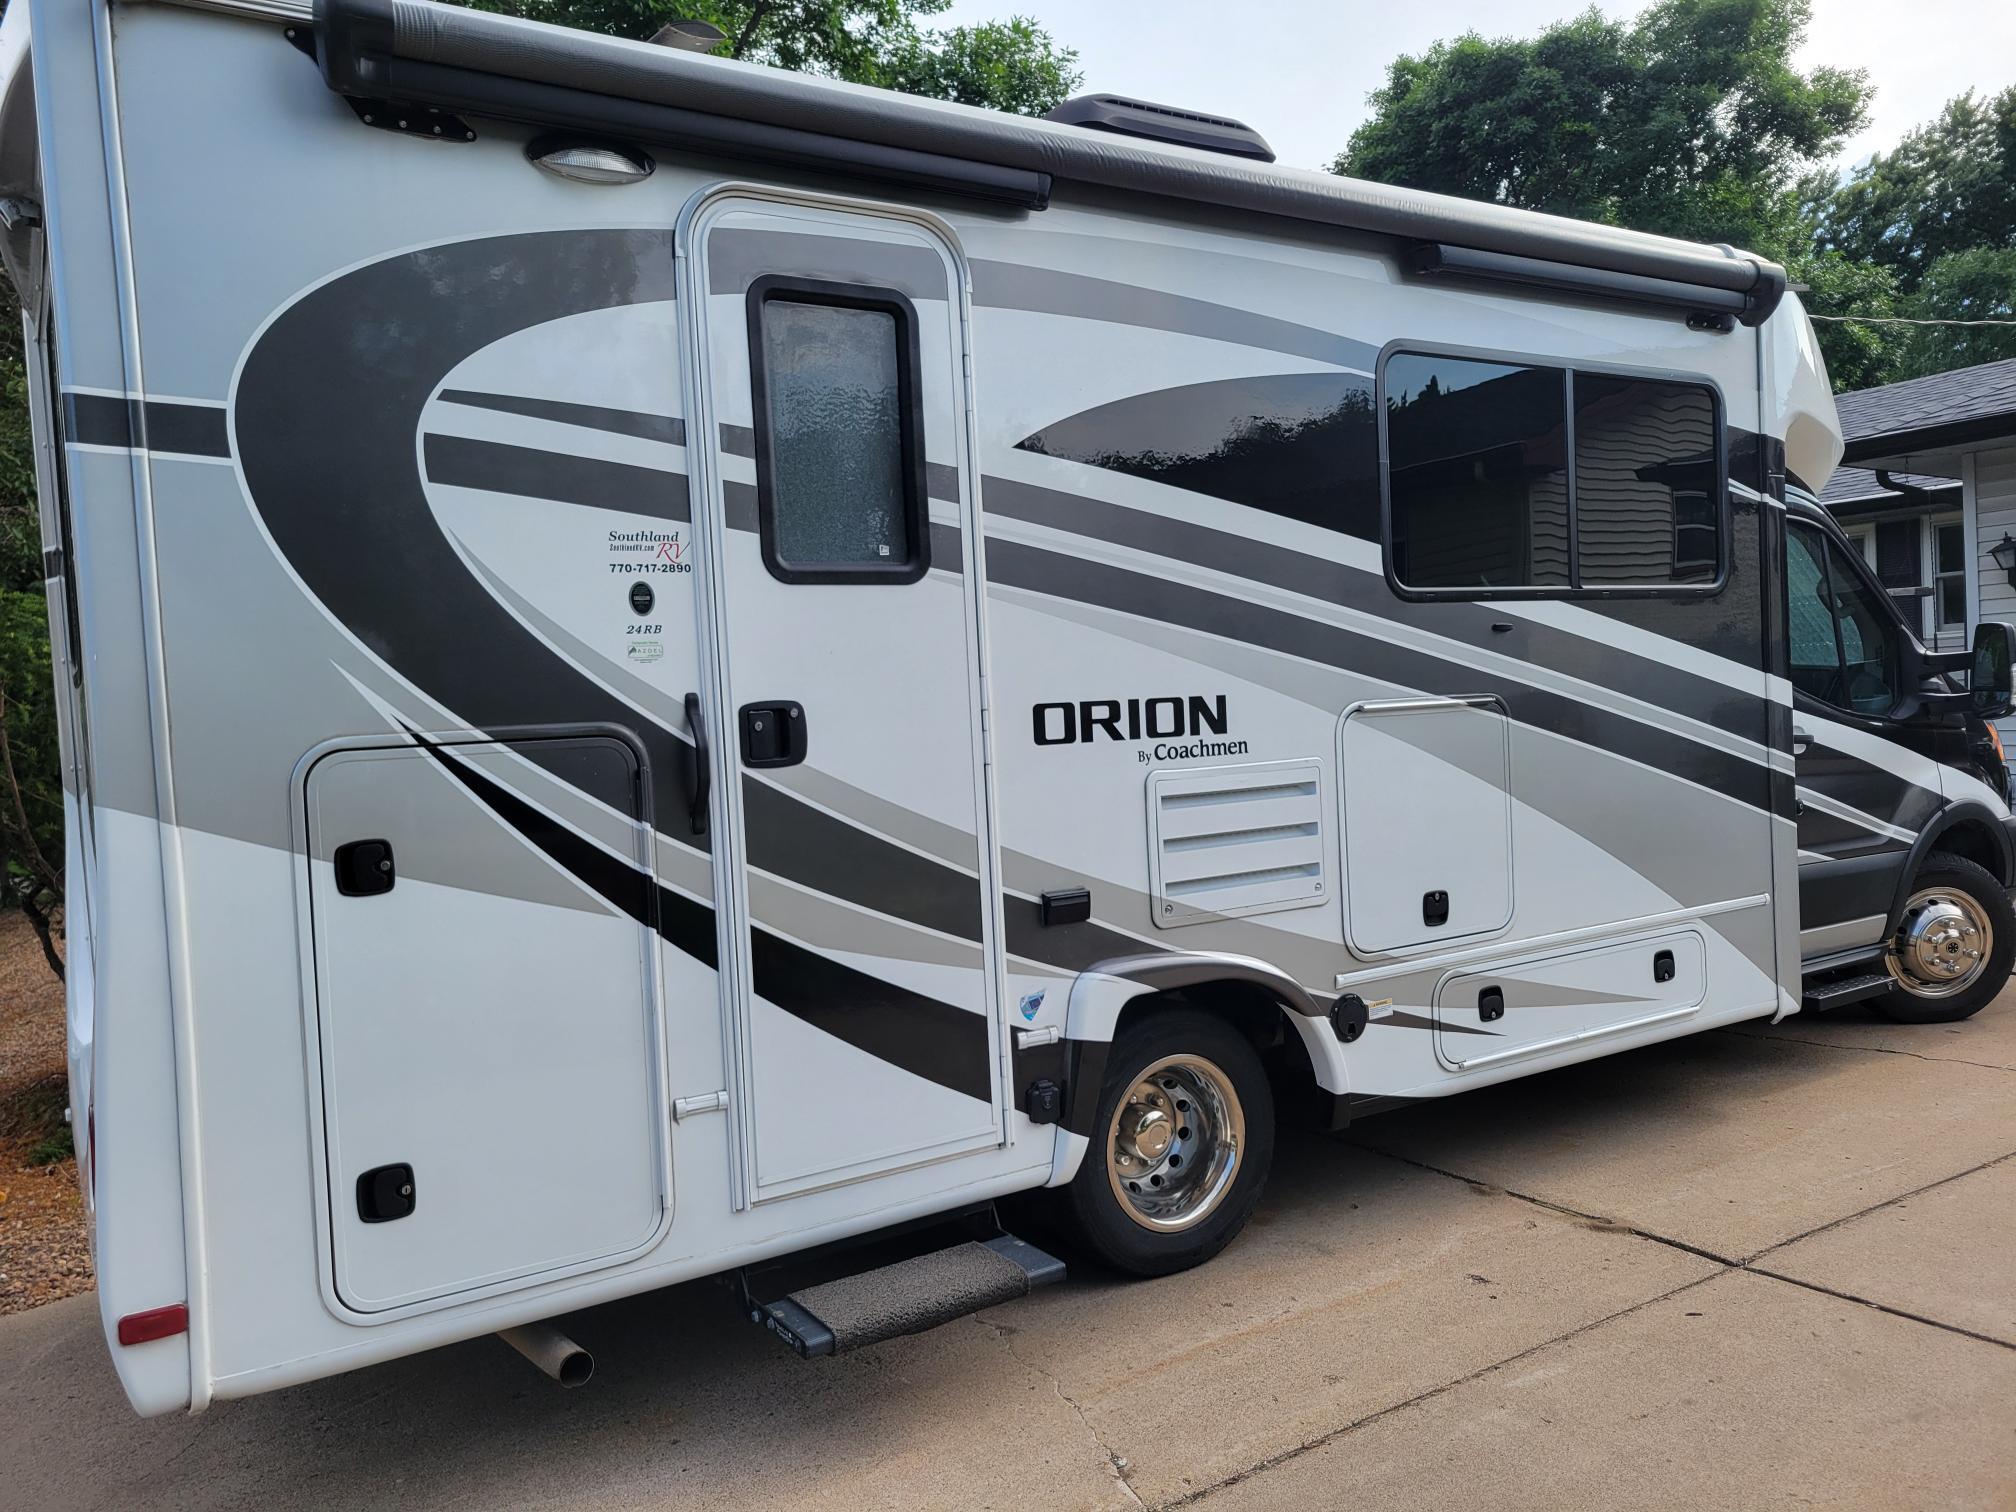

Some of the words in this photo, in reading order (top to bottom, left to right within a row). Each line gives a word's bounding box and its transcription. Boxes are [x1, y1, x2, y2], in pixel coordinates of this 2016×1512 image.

[608, 530, 679, 542] Southland
[656, 542, 691, 565] RV
[609, 563, 691, 573] 770-717-2890
[1032, 695, 1228, 746] ORION
[1137, 750, 1152, 766] By
[1154, 739, 1249, 761] Coachmen
